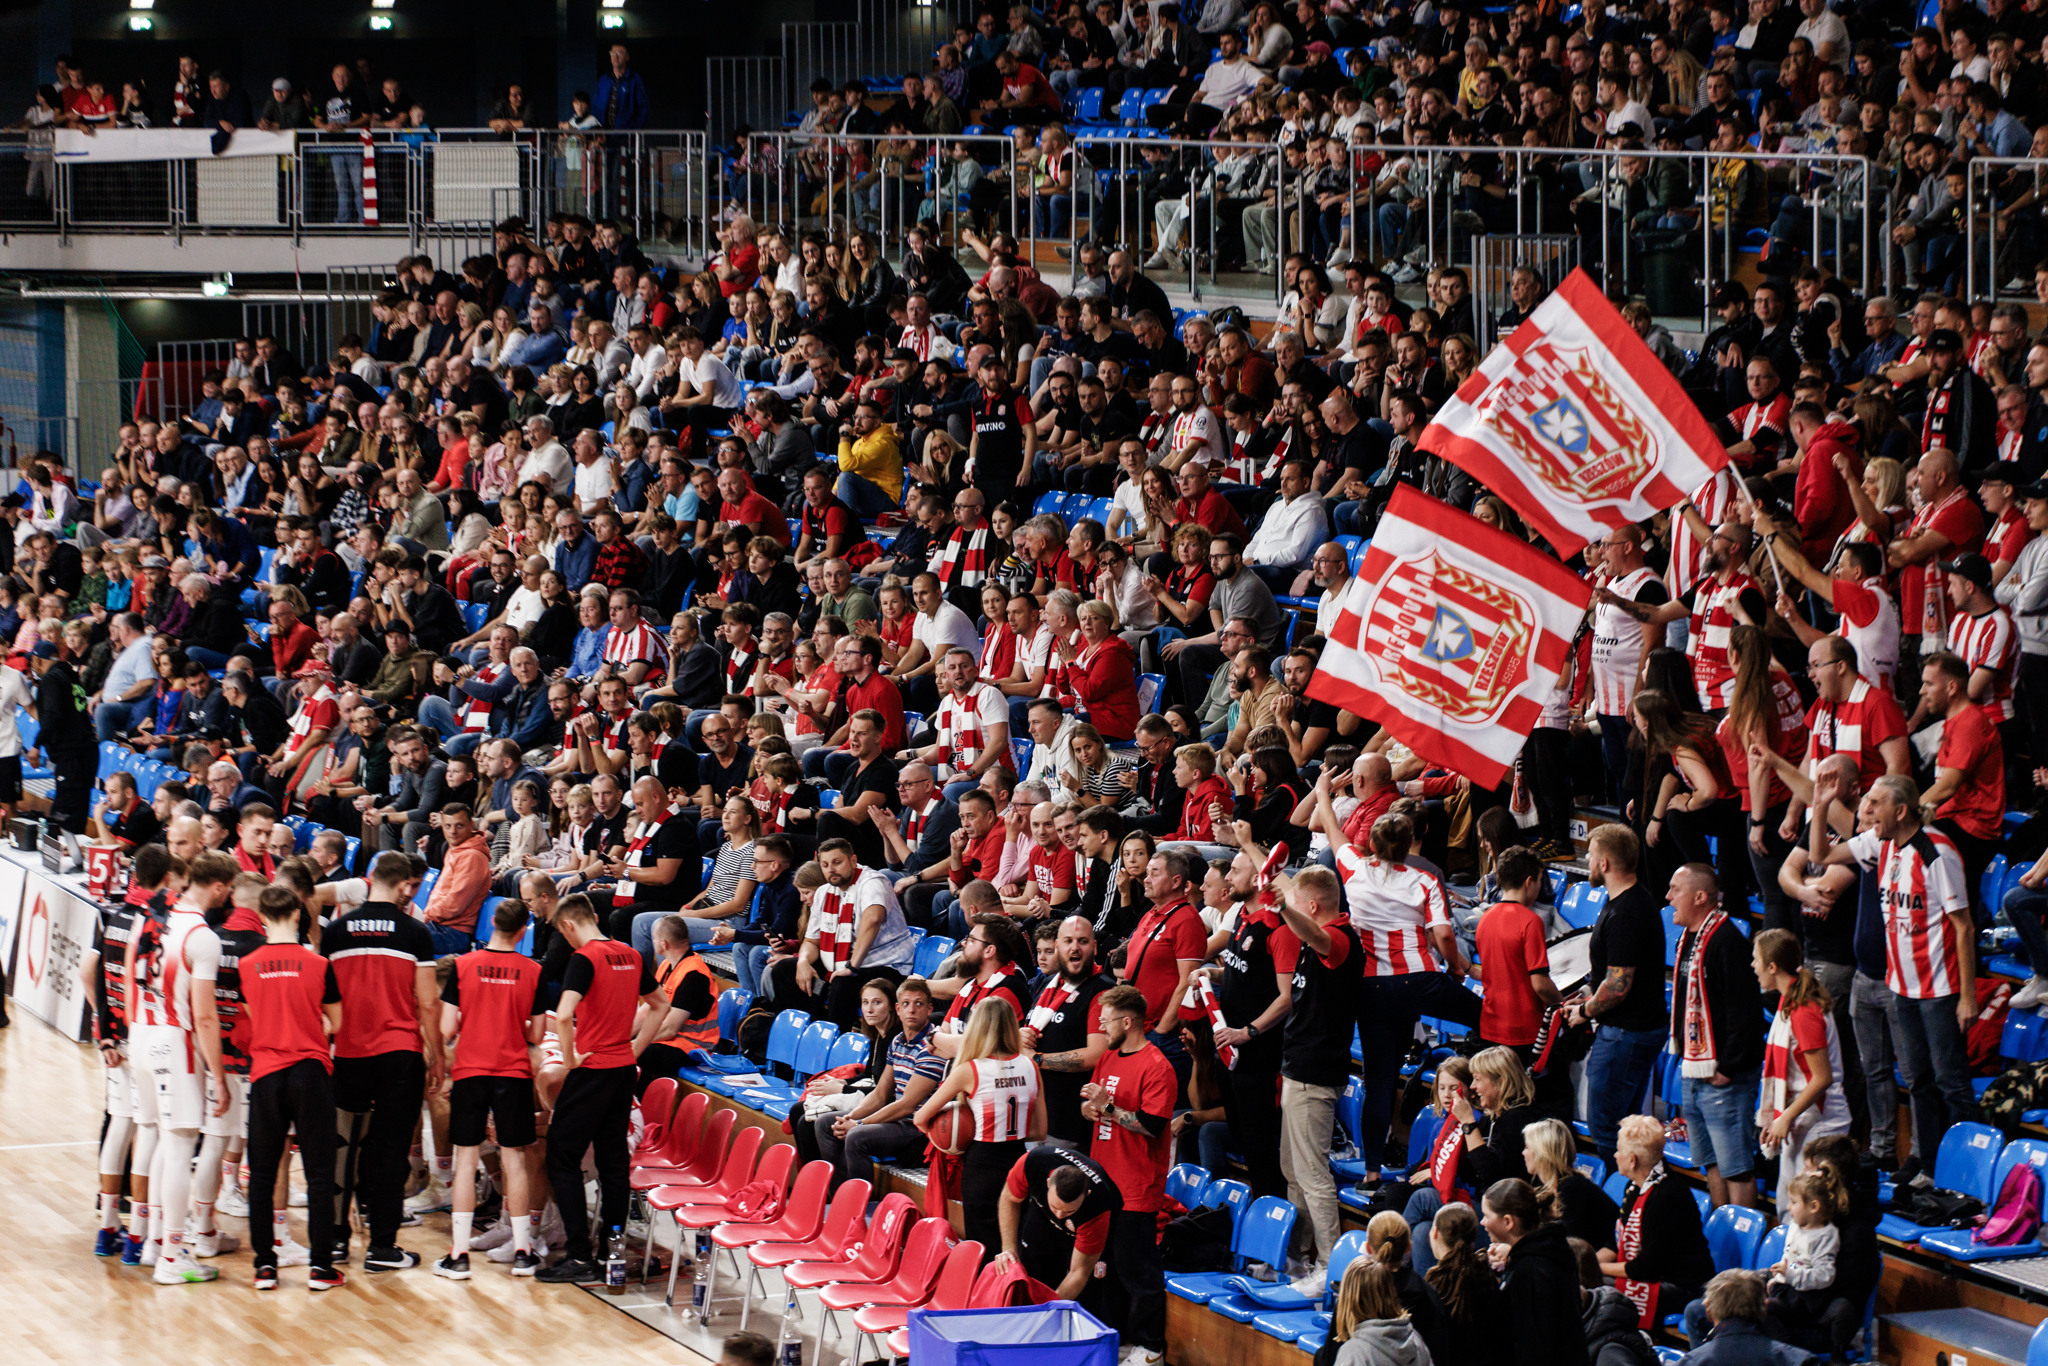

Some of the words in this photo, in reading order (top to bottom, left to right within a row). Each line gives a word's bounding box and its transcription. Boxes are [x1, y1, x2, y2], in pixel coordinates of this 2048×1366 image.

[1381, 573, 1433, 663] RESOVIA
[1593, 634, 1619, 646] Team
[91, 853, 109, 884] 5
[1880, 887, 1924, 911] ESOVIA
[346, 919, 396, 933] RESOVIA
[255, 959, 303, 974] RESOVIA
[476, 965, 521, 981] RESOVIA
[994, 1075, 1027, 1089] RESOVIA
[1006, 1095, 1018, 1137] 1
[1054, 1147, 1103, 1185] RESOVIA
